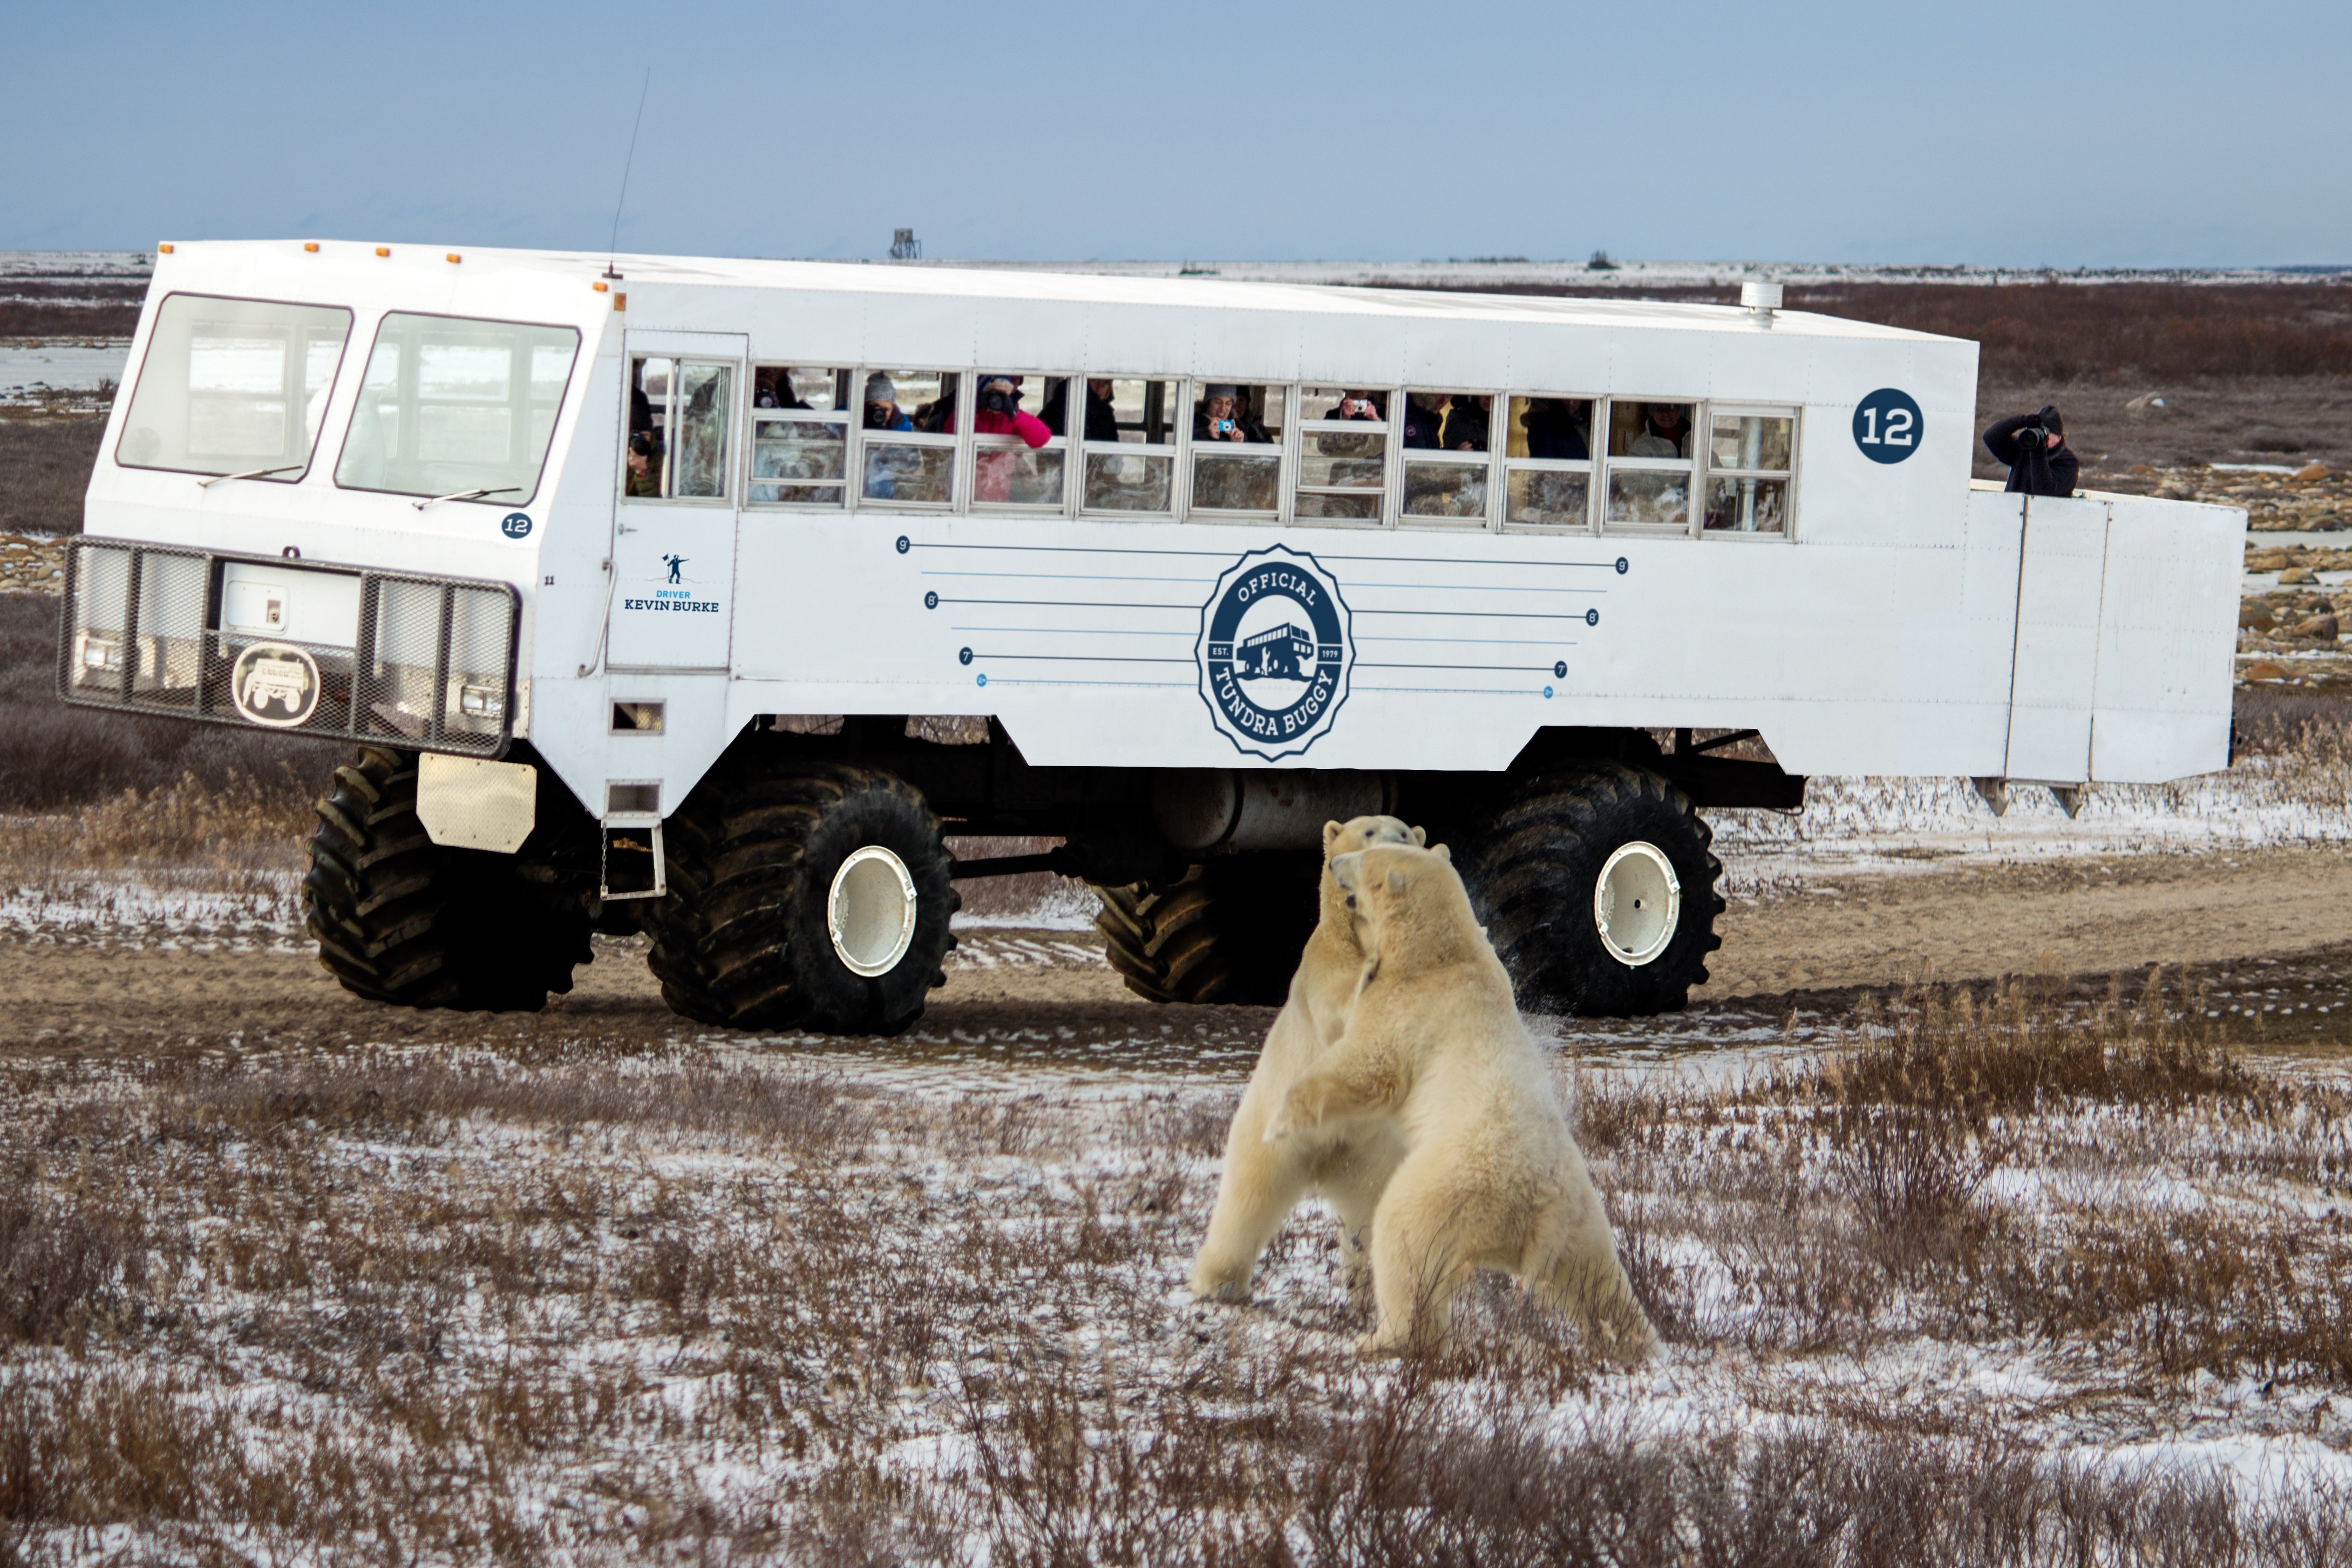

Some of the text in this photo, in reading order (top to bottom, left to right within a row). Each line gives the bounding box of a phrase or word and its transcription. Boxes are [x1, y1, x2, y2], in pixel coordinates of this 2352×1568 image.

[1862, 407, 1913, 446] 12
[505, 518, 528, 533] 12
[545, 575, 555, 585] 11
[656, 590, 690, 599] DRIVER
[1238, 572, 1316, 606] OFFICIAL
[624, 599, 719, 612] KEVIN BURKE
[1215, 667, 1333, 736] TUNDRA BUGGY
